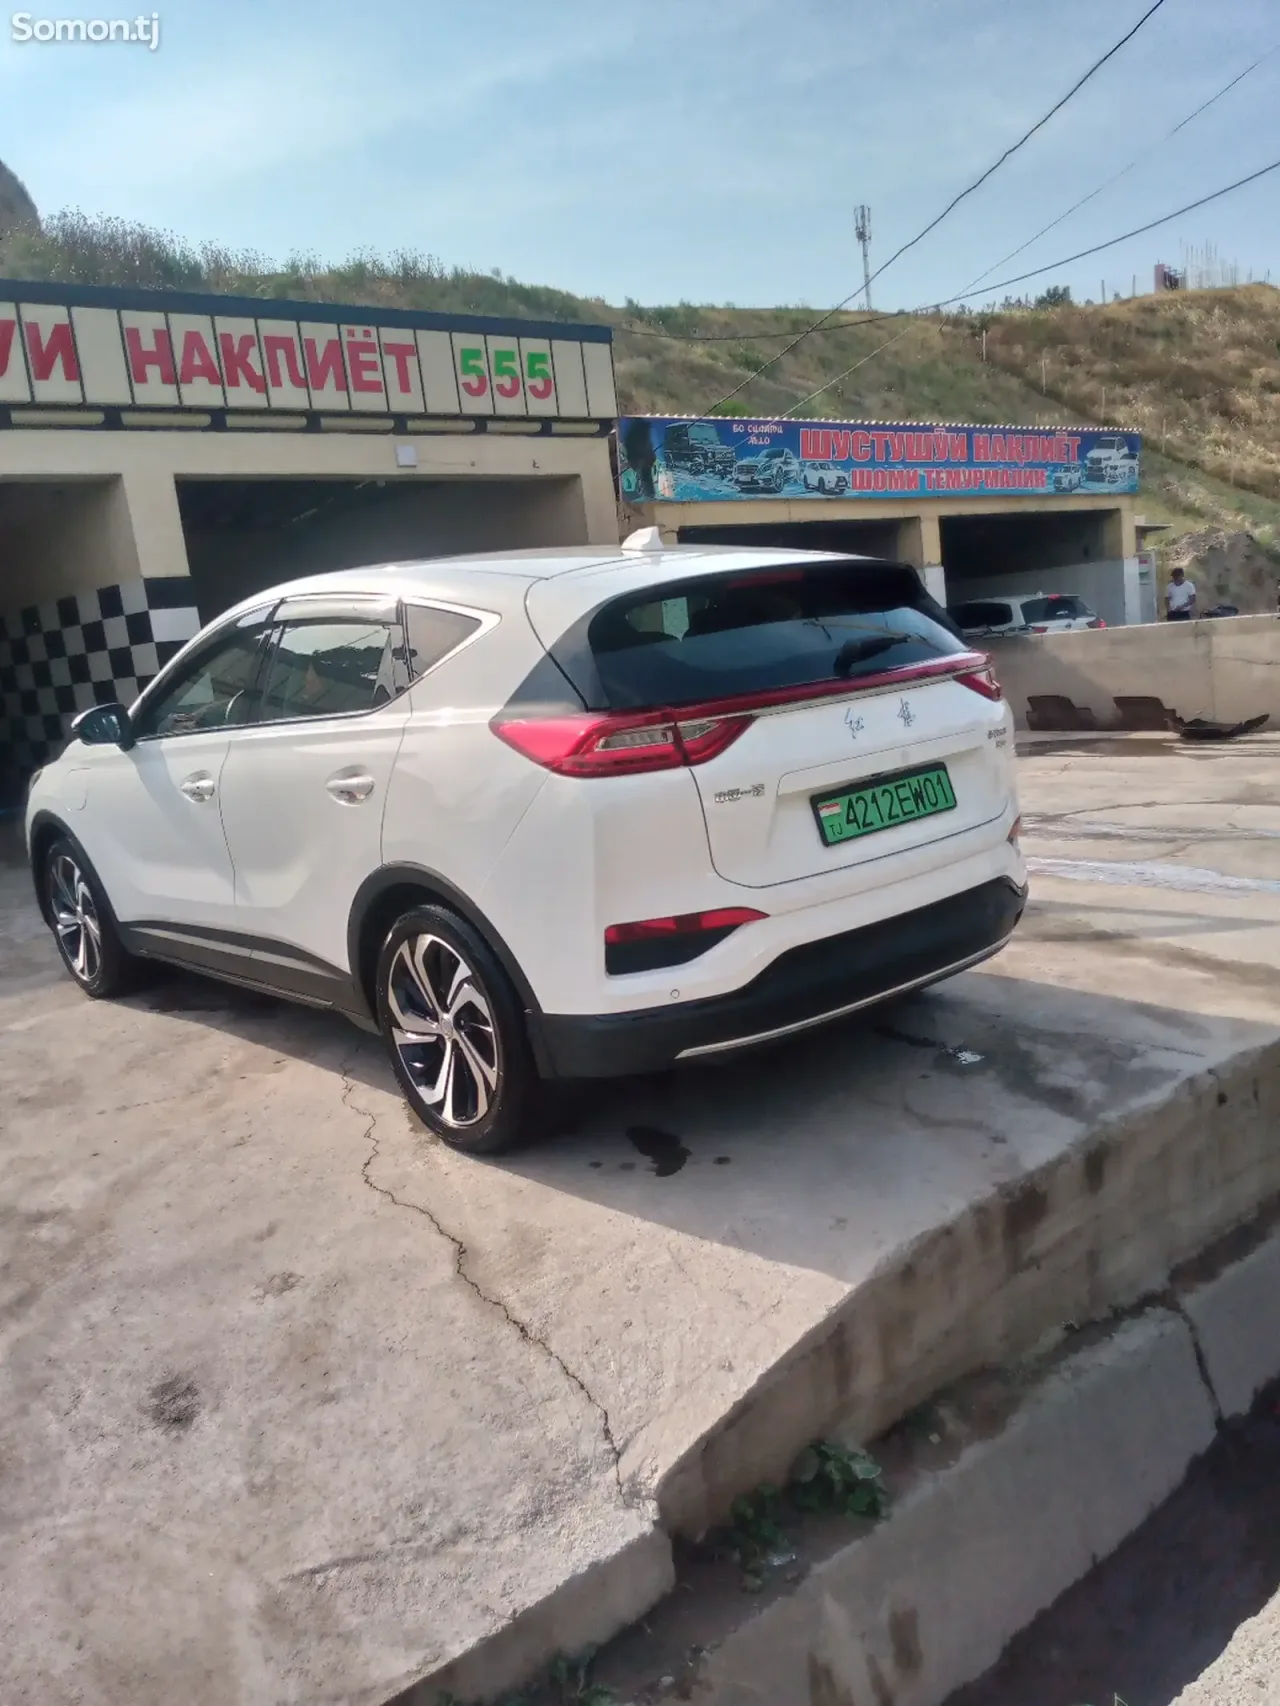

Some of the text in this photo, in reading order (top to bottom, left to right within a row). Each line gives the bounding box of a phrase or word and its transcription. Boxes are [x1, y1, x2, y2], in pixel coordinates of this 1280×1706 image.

[0, 319, 80, 381] И
[460, 348, 553, 399] 555
[829, 823, 844, 837] TJ
[845, 773, 949, 831] 4212EW01
